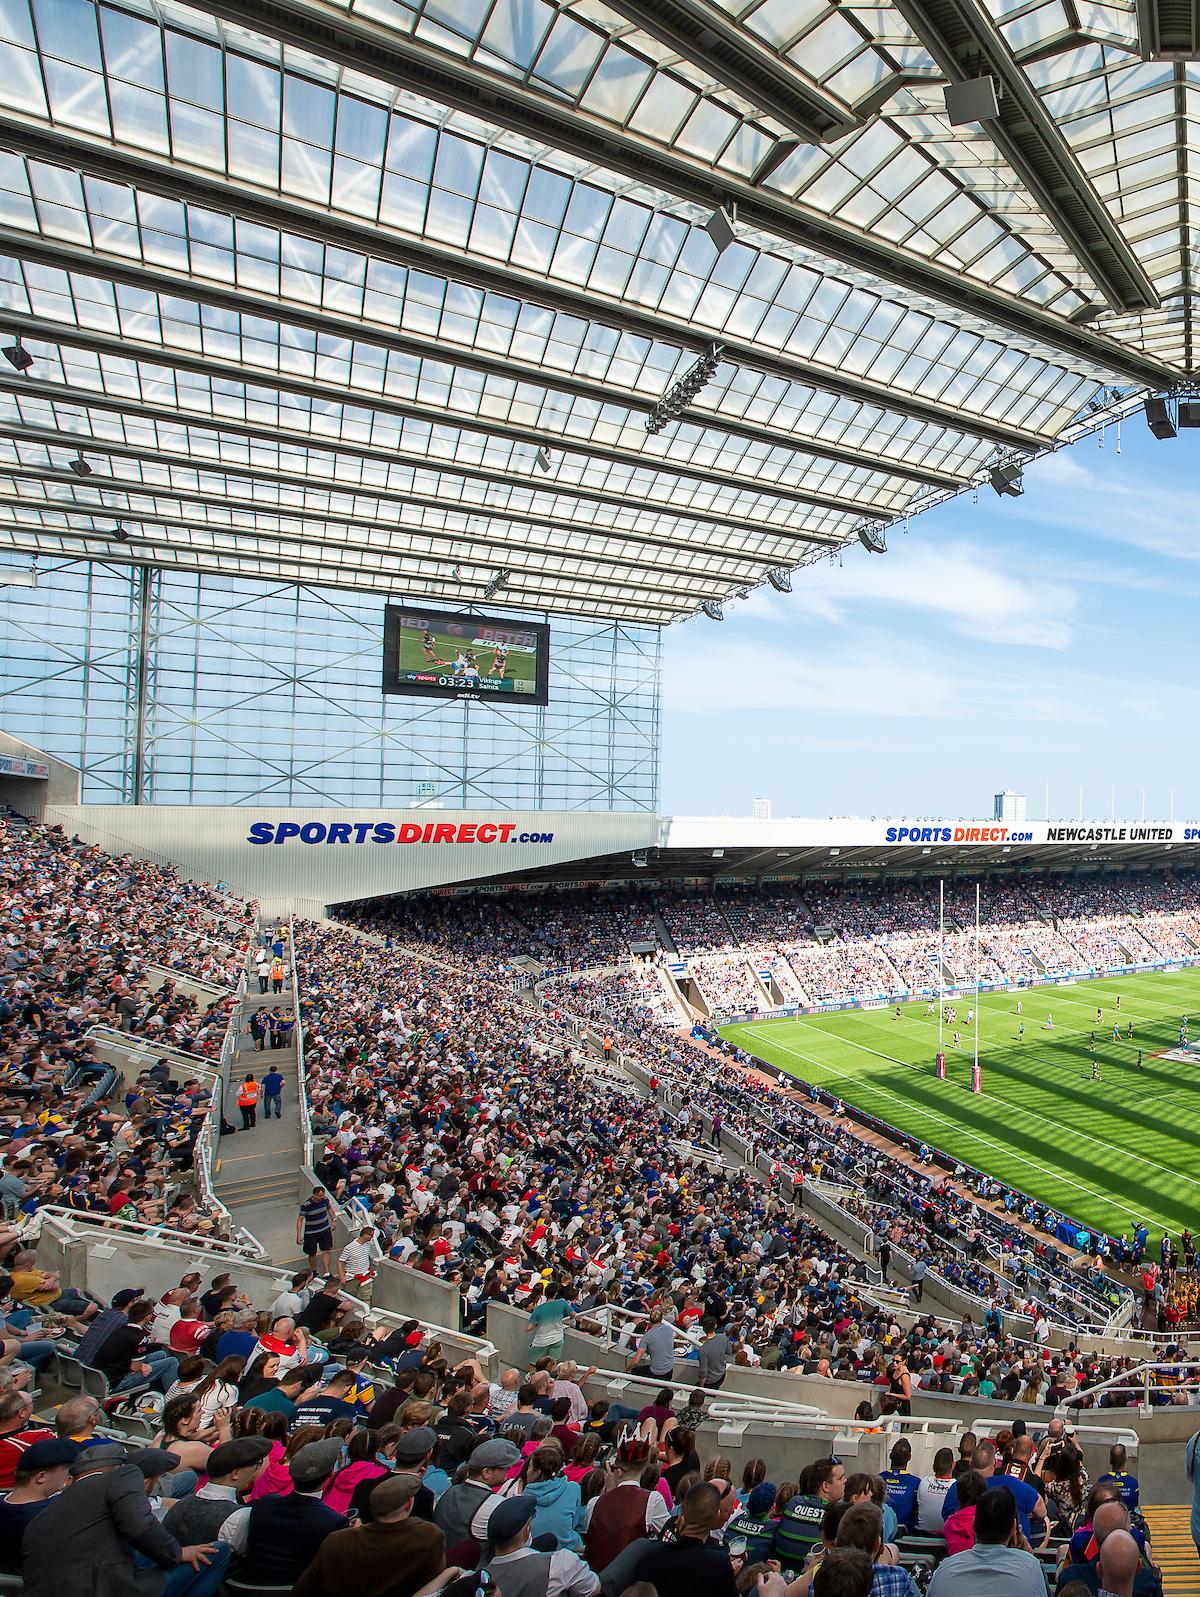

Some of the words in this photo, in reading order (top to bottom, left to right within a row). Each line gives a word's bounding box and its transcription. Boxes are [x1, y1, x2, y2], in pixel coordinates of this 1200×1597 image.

[438, 676, 475, 689] 03:23
[479, 677, 502, 685] Vikings
[479, 683, 500, 691] Saints
[1046, 828, 1127, 842] NEWCASTLE
[1129, 828, 1173, 841] UNITED
[809, 1004, 841, 1014] BETFRED
[754, 1010, 788, 1021] BETFRED
[794, 1504, 826, 1518] QUEST
[738, 1519, 765, 1532] QUEST
